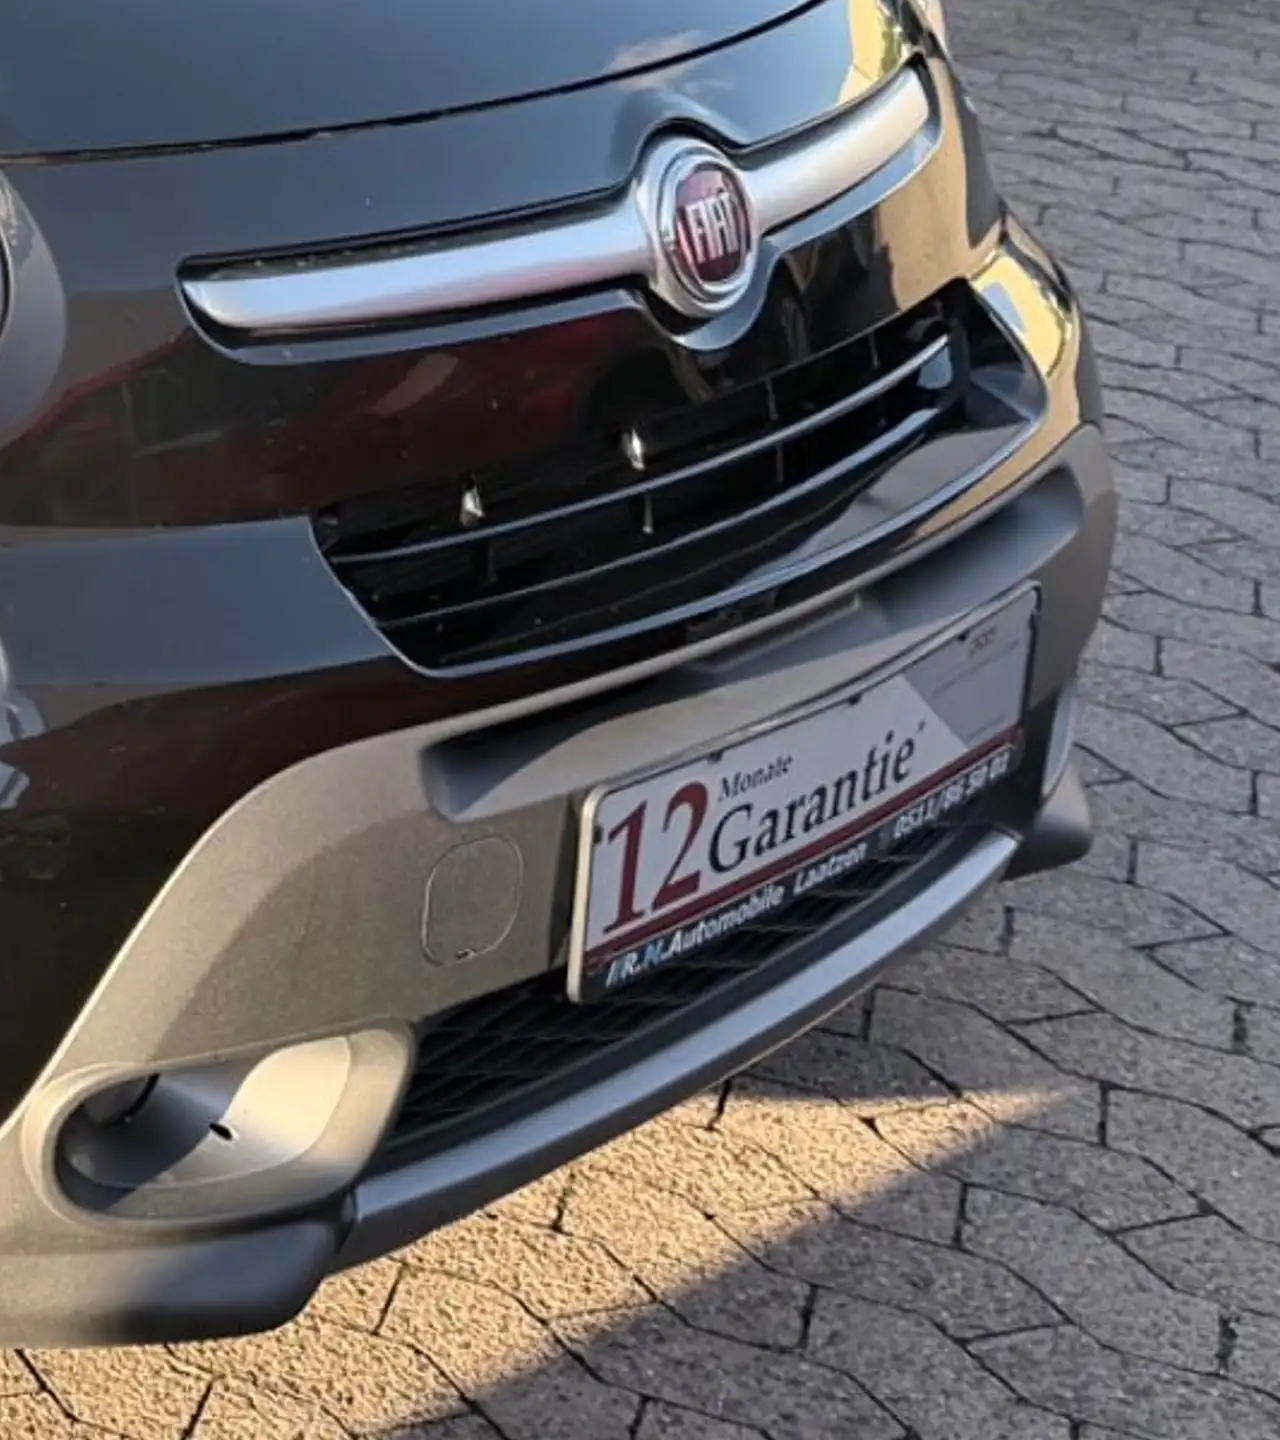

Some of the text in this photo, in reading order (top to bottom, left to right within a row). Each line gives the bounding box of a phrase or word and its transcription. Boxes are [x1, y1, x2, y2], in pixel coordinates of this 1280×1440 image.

[685, 191, 739, 264] FIAT
[717, 753, 794, 803] Monate
[603, 731, 916, 935] 12 Garantie
